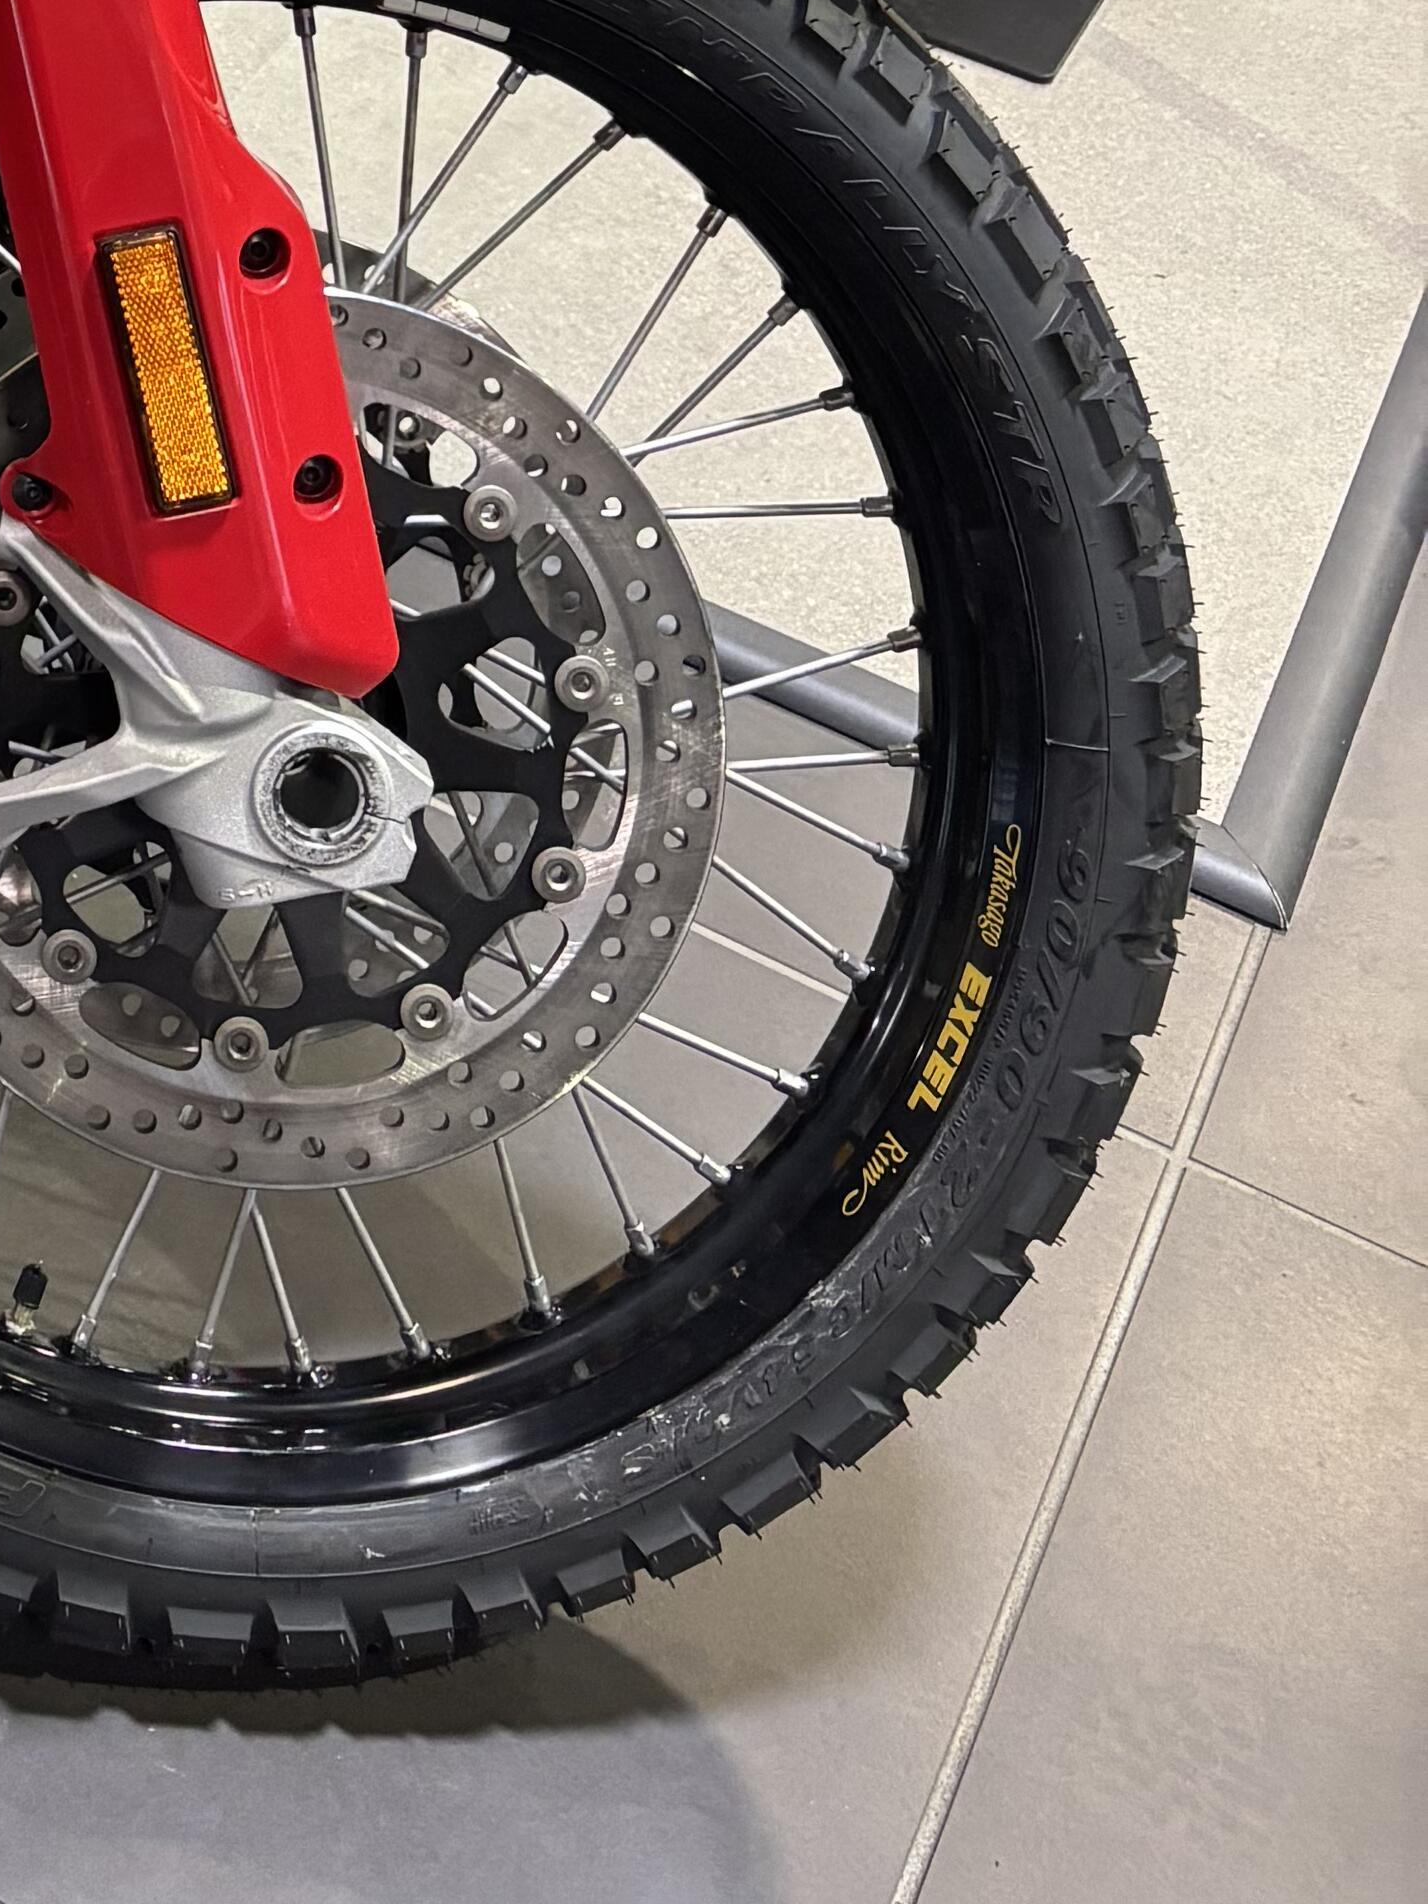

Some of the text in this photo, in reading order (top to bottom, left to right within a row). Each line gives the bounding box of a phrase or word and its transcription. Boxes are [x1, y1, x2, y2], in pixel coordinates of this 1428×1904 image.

[976, 823, 1022, 948] Takasago
[907, 961, 992, 1112] EXCEL
[842, 1129, 909, 1216] Rim
